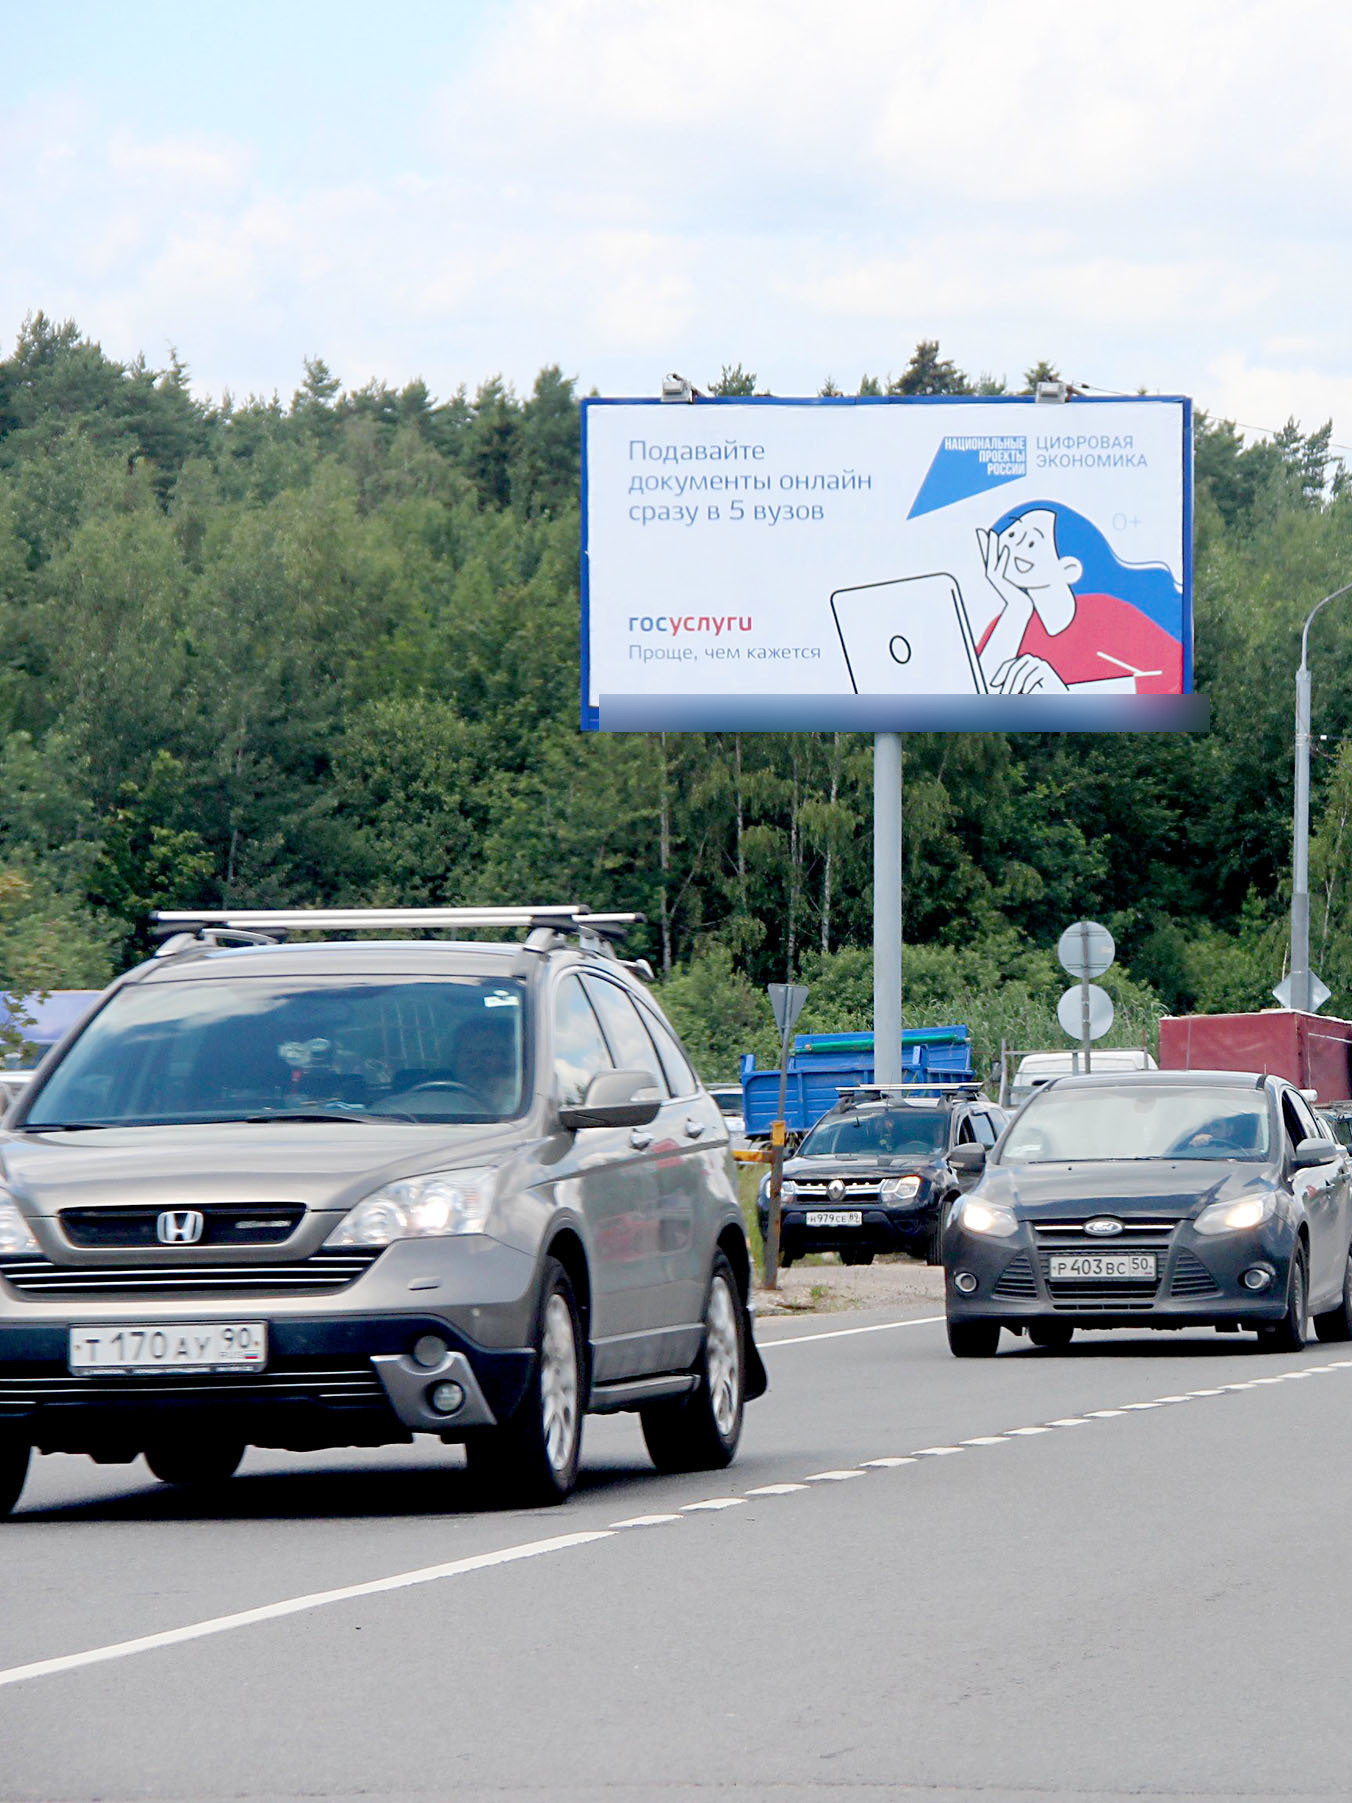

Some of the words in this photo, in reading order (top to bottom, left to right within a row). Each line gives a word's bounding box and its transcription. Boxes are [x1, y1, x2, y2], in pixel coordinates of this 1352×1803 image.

[629, 440, 766, 465] Подавайте
[945, 436, 1025, 451] НАЦИОНАЛЬНЫЕ
[1036, 436, 1134, 451] ЦИФРОВАЯ
[979, 451, 1025, 463] ПРОЕКТЫ
[1036, 454, 1148, 467] ЭКОНОМИКА
[987, 463, 1026, 476] РОССИИ
[628, 473, 772, 497] документы
[779, 468, 872, 490] онлайн
[628, 504, 699, 526] сразу
[707, 505, 721, 520] в
[729, 500, 745, 520] 5
[753, 504, 825, 526] вузов
[628, 616, 752, 636] госуслуги
[628, 645, 699, 664] Проще,
[704, 648, 741, 660] чем
[747, 647, 822, 660] кажется
[221, 1327, 251, 1349] 90
